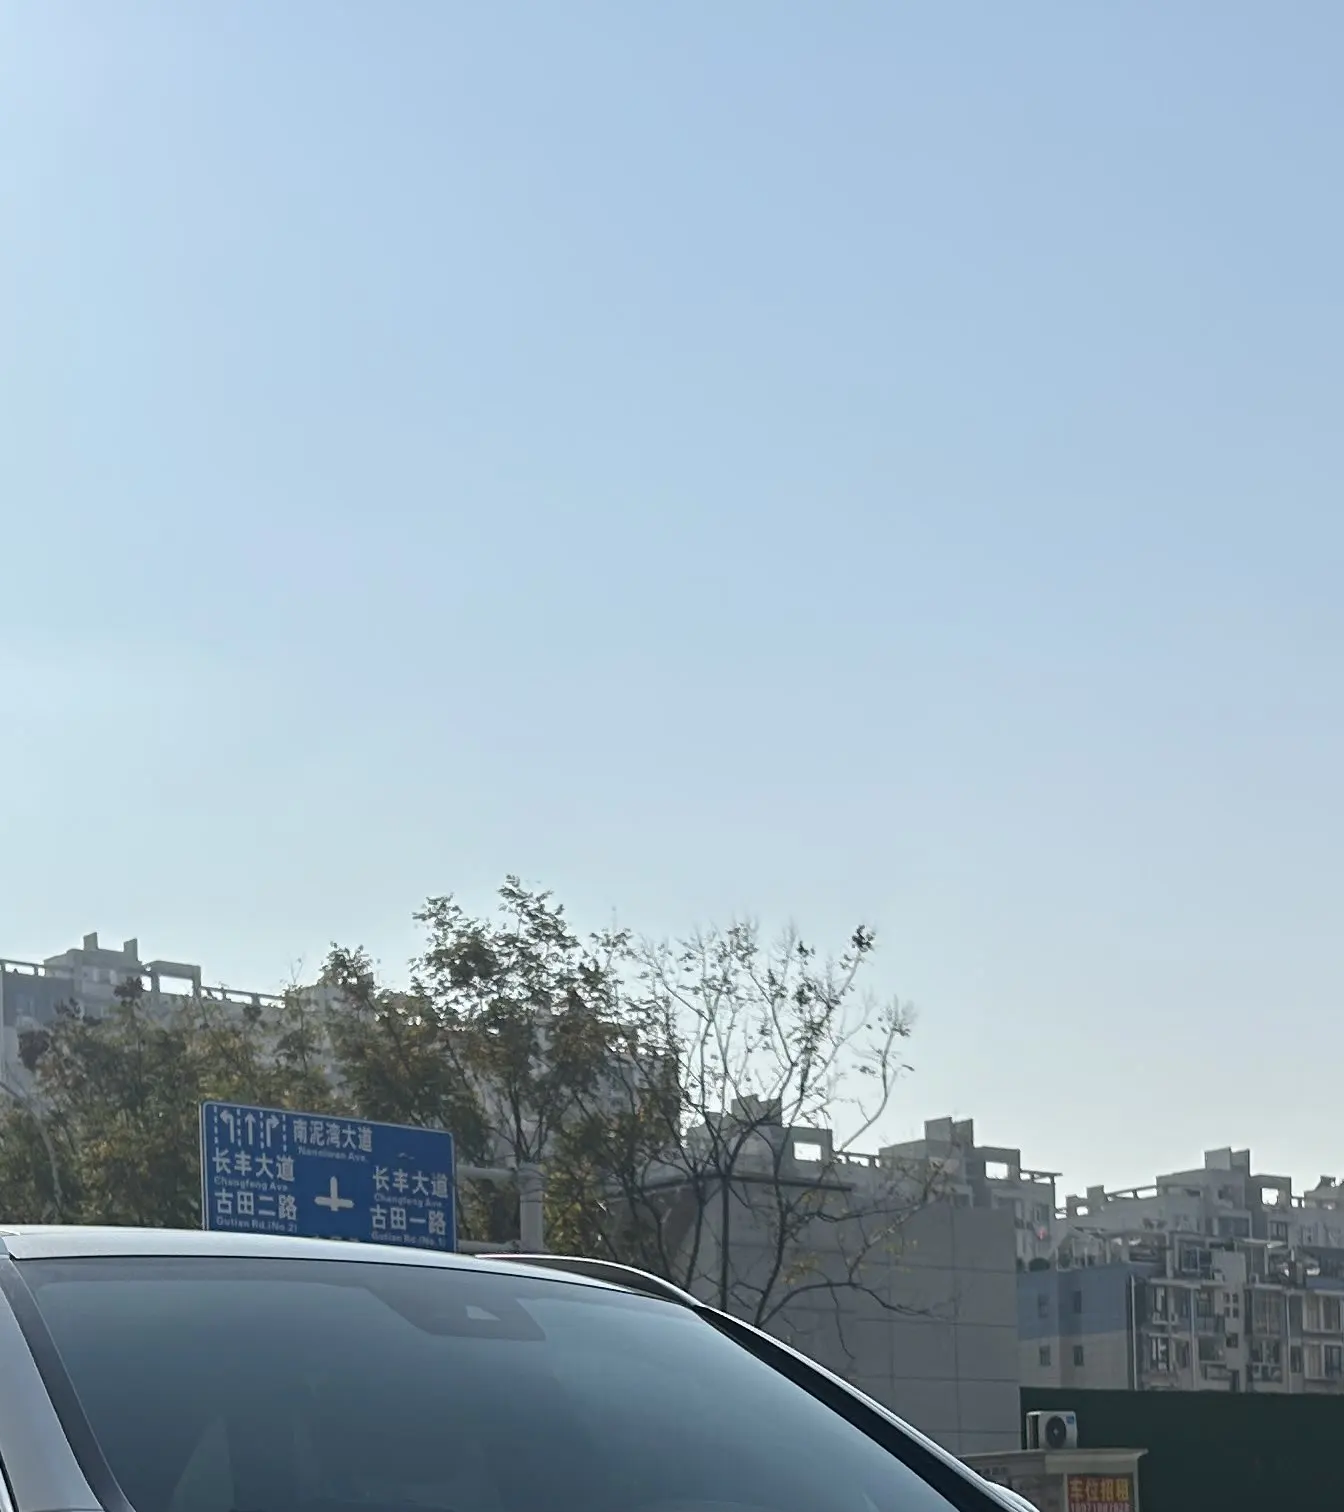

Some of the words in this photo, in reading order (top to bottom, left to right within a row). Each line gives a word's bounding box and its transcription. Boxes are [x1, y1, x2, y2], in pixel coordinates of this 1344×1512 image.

[293, 1119, 373, 1152] 南泥湾大道
[212, 1147, 295, 1182] 长丰大道
[372, 1165, 448, 1199] 长丰大道
[214, 1188, 297, 1220] 古田二路
[370, 1204, 446, 1235] 古田一路
